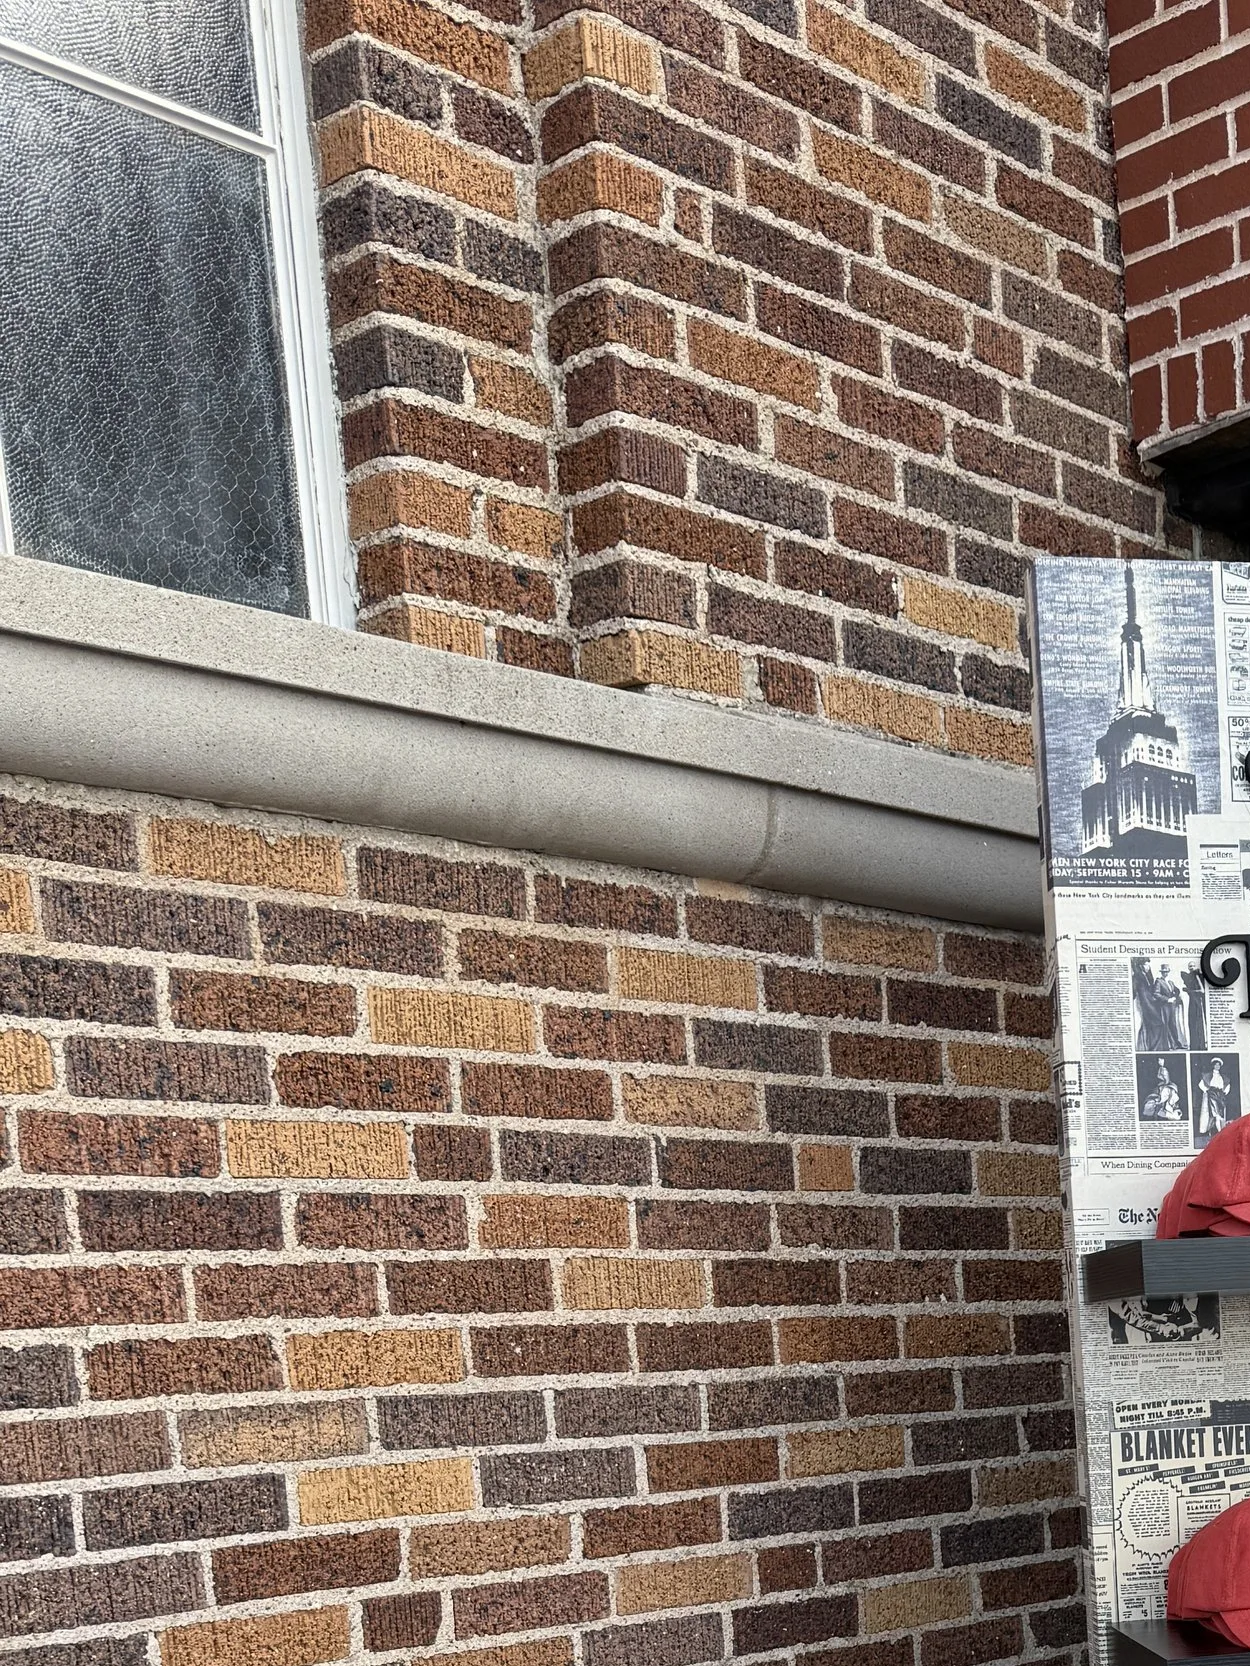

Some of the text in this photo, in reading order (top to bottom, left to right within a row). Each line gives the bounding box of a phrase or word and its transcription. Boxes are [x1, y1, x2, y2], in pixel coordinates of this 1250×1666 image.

[1206, 850, 1234, 859] Letters
[1073, 858, 1178, 868] NEW YORK CITY RACE
[1076, 868, 1174, 878] SEPTEMBER 15 9AM
[1101, 892, 1113, 900] City
[1080, 944, 1203, 956] Student Designs at Parsons
[1101, 1160, 1153, 1170] When Dining
[1118, 1207, 1144, 1226] The
[1115, 1400, 1168, 1414] OPEN EVERY
[1119, 1412, 1146, 1423] NIGHT
[1147, 1410, 1164, 1420] TILL
[1166, 1408, 1185, 1417] 8:45
[1120, 1427, 1207, 1463] BLANKET
[1186, 1503, 1222, 1511] BLANKETS
